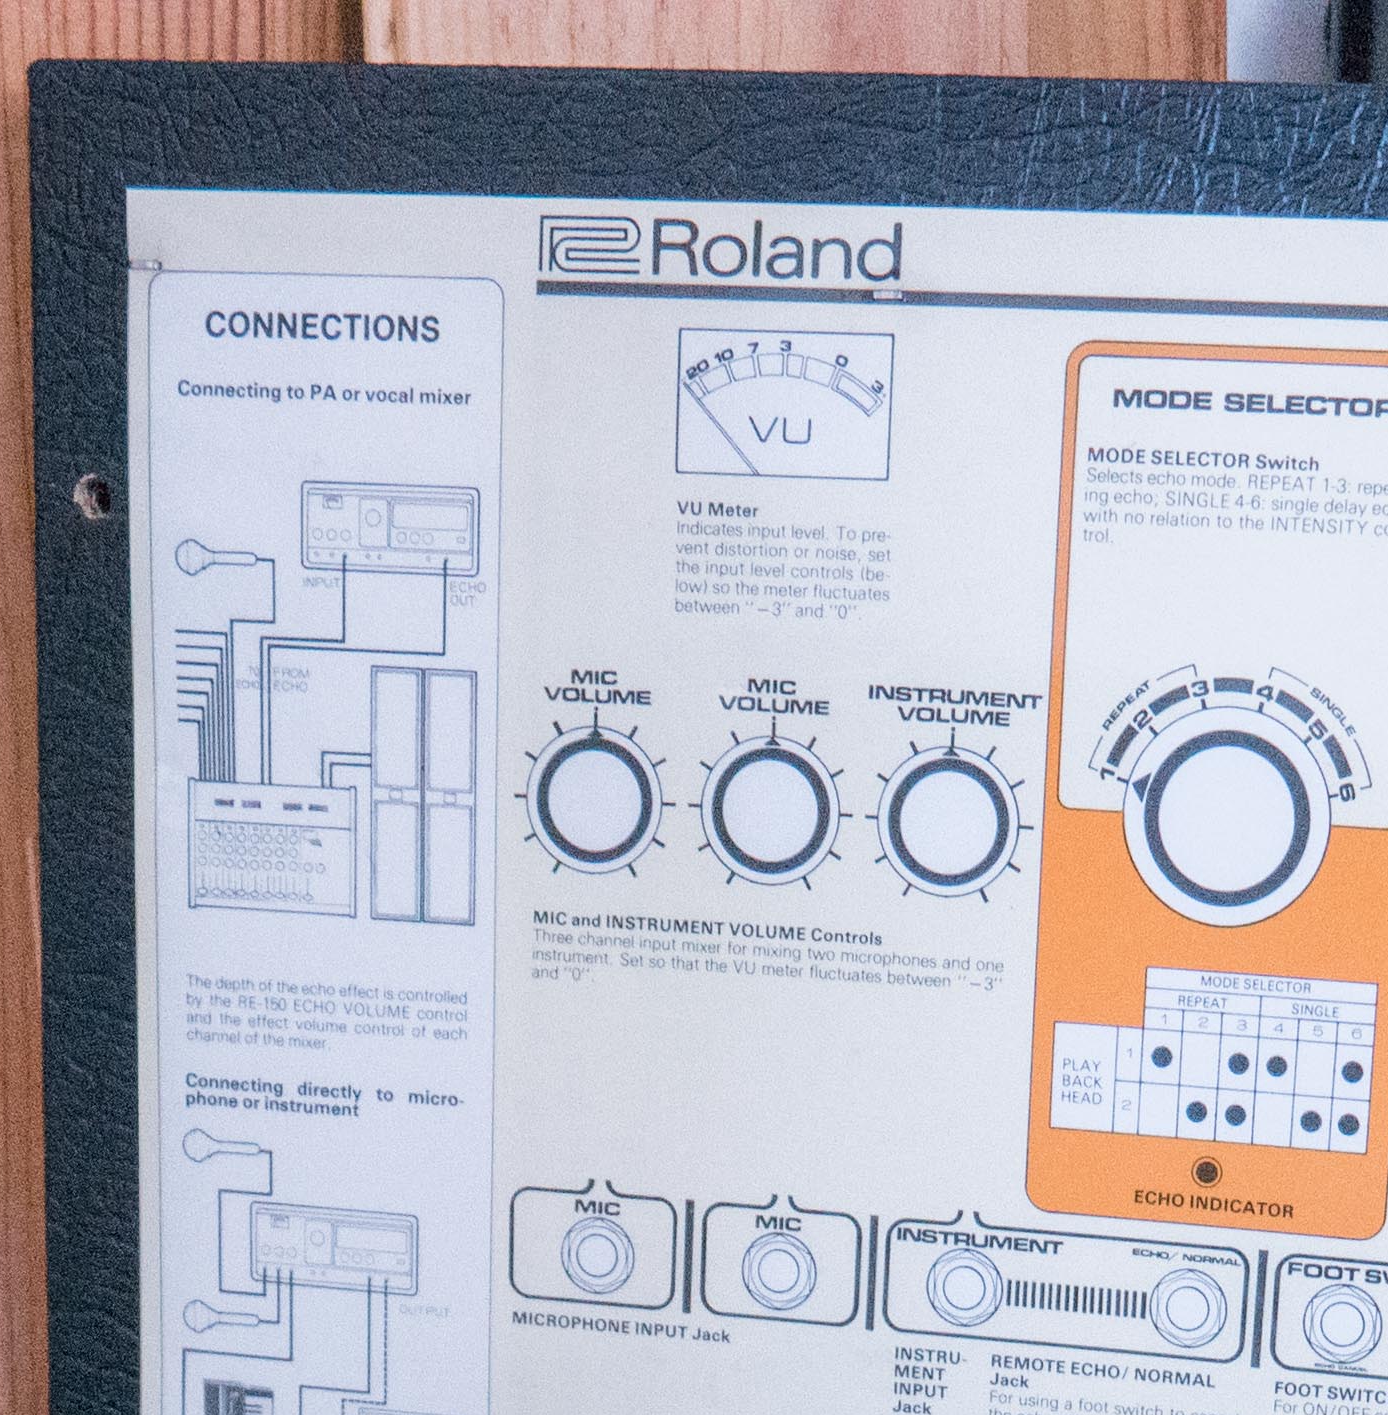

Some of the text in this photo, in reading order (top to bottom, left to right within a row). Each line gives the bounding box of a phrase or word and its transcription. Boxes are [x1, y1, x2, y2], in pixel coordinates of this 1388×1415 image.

[651, 217, 903, 283] Roland
[204, 309, 440, 343] CONNECTIONS
[176, 378, 471, 406] Connecting to PA or vocal mixer
[1112, 388, 1213, 411] MODE
[747, 415, 812, 446] VU
[1086, 446, 1320, 471] MODE SELECTOR Switch
[1086, 467, 1143, 485] Selects
[1147, 471, 1187, 486] echo
[1190, 473, 1242, 490] mode.
[1247, 473, 1316, 493] REPEAT
[1323, 478, 1352, 494] 1-3:
[676, 500, 758, 518] VU Meter
[675, 519, 891, 544] Indicates input level. To pre-
[674, 540, 891, 563] vent distortion or noise, set
[570, 668, 618, 686] MIC
[746, 677, 797, 696] MIC
[543, 686, 651, 706] VOLUME
[718, 694, 829, 716] VOLUME
[867, 684, 1043, 709] INSTRUMENT
[1101, 680, 1152, 731] REPEAT
[896, 705, 1010, 727] VOLUME
[1308, 686, 1356, 738] SINGLE
[532, 909, 882, 946] MIC and INSTRUMENT VOLUME Controls
[1199, 974, 1312, 993] MODE SELECTOR
[1176, 994, 1227, 1009] REPEAT
[1290, 1002, 1339, 1018] SINGLE
[1061, 1057, 1101, 1072] PLAY
[184, 1071, 464, 1107] Connecting directly to micro-
[1061, 1073, 1102, 1089] BACK
[184, 1089, 359, 1117] phone or instrument
[1060, 1089, 1103, 1105] HEAD
[574, 1198, 621, 1216] MIC
[1133, 1188, 1294, 1219] ECHO INDICATOR
[754, 1214, 802, 1232] MIC
[895, 1226, 1064, 1254] INSTRUMENT
[1284, 1258, 1361, 1282] FOOT
[511, 1310, 730, 1343] MICROPHONE INPUT Jack
[894, 1346, 967, 1365] INSTRU-
[893, 1363, 945, 1381] MENT
[988, 1371, 1029, 1389] Jack
[990, 1353, 1215, 1388] REMOTE ECHO/ NORMAL
[892, 1381, 948, 1399] INPUT
[1273, 1380, 1323, 1398] FOOT
[891, 1399, 932, 1415] Jack
